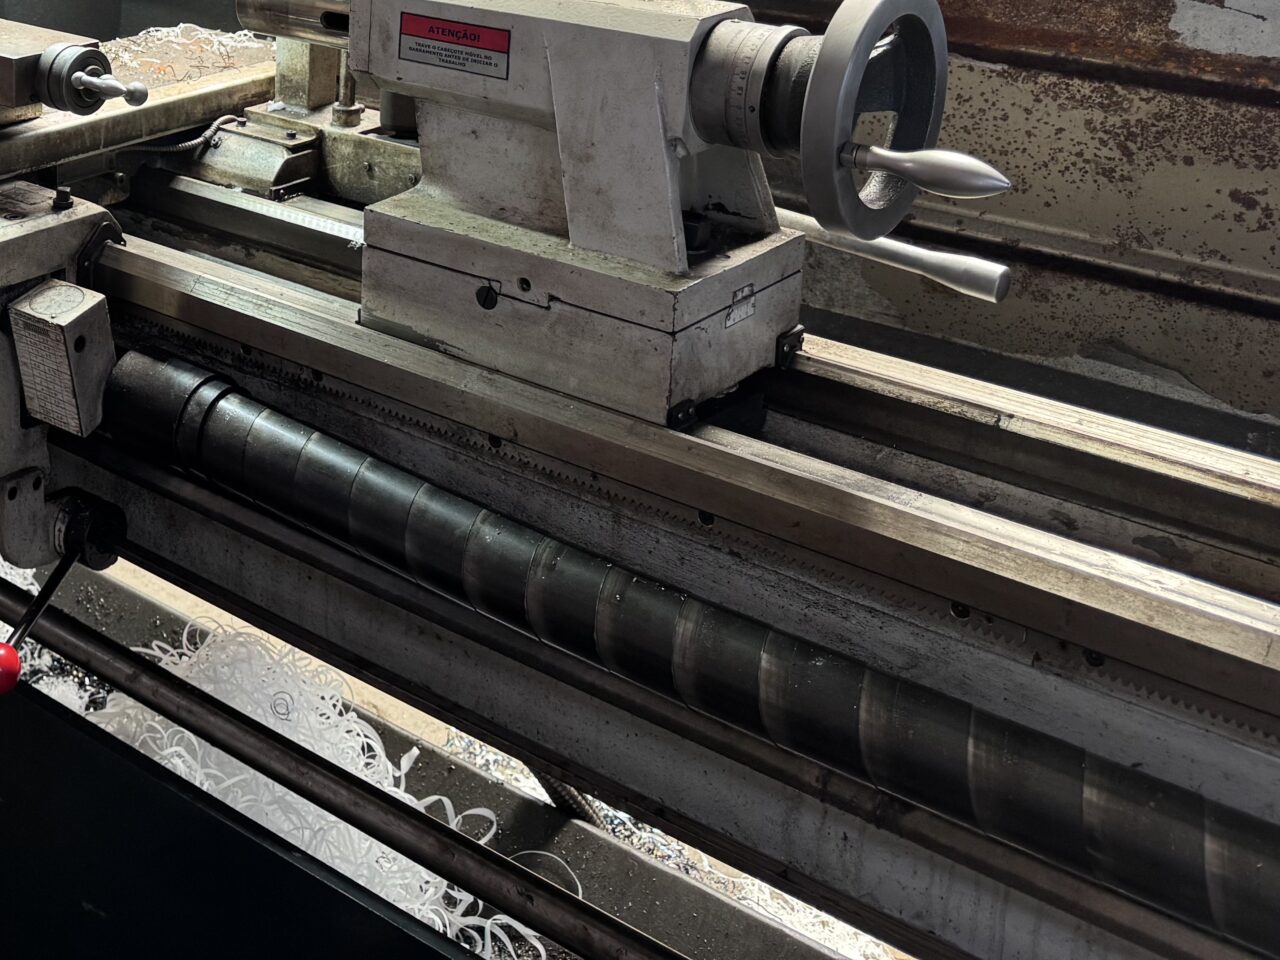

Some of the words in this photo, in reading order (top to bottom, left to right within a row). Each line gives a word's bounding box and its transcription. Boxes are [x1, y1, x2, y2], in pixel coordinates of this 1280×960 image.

[427, 25, 481, 42] ATENÇÃO!
[408, 46, 444, 58] BARRAMENTO
[444, 53, 461, 62] ANTES
[470, 58, 493, 67] INICIAR
[415, 41, 431, 50] TRAVE
[436, 45, 464, 56] CABEÇOTE
[465, 49, 483, 59] MÓVEL
[438, 57, 466, 68] TRABALHO
